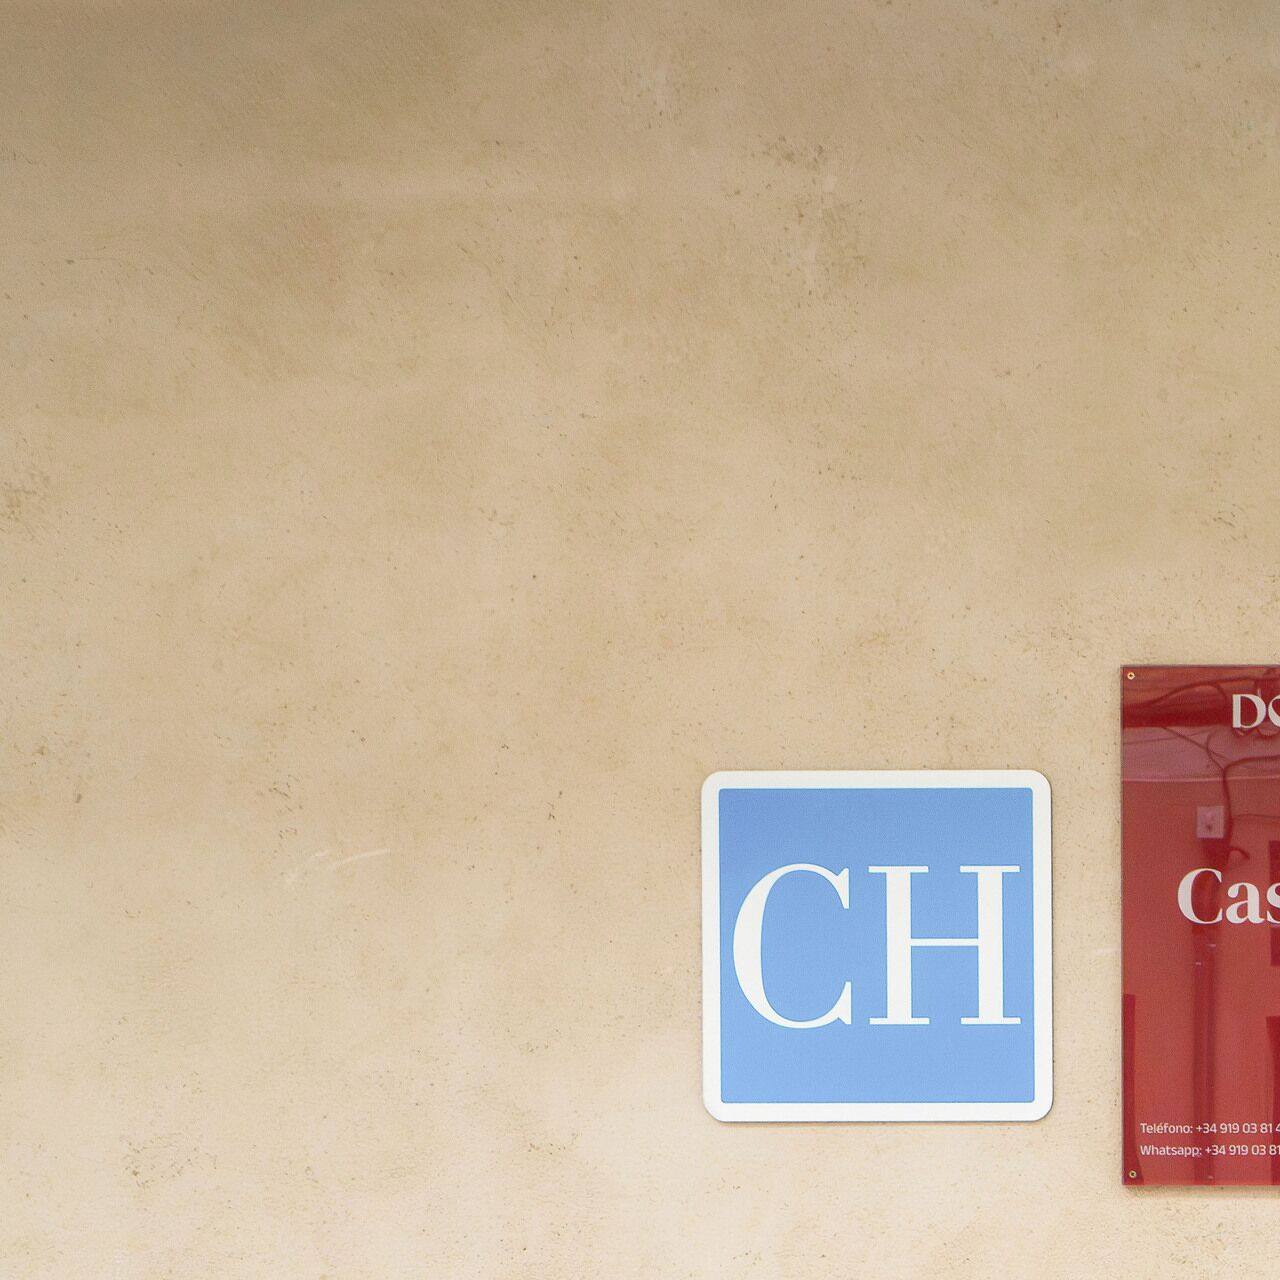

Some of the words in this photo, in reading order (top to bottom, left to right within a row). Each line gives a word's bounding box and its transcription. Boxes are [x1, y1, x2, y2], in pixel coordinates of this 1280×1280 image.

[732, 863, 1022, 1030] CH
[1139, 1122, 1194, 1134] Teléfono:
[1195, 1122, 1218, 1134] +34
[1219, 1122, 1240, 1134] 919
[1241, 1122, 1258, 1134] 03
[1259, 1122, 1273, 1134] 81
[1139, 1144, 1202, 1158] Whatsapp:
[1204, 1144, 1227, 1156] +34
[1228, 1144, 1249, 1156] 919
[1250, 1144, 1267, 1156] 03
